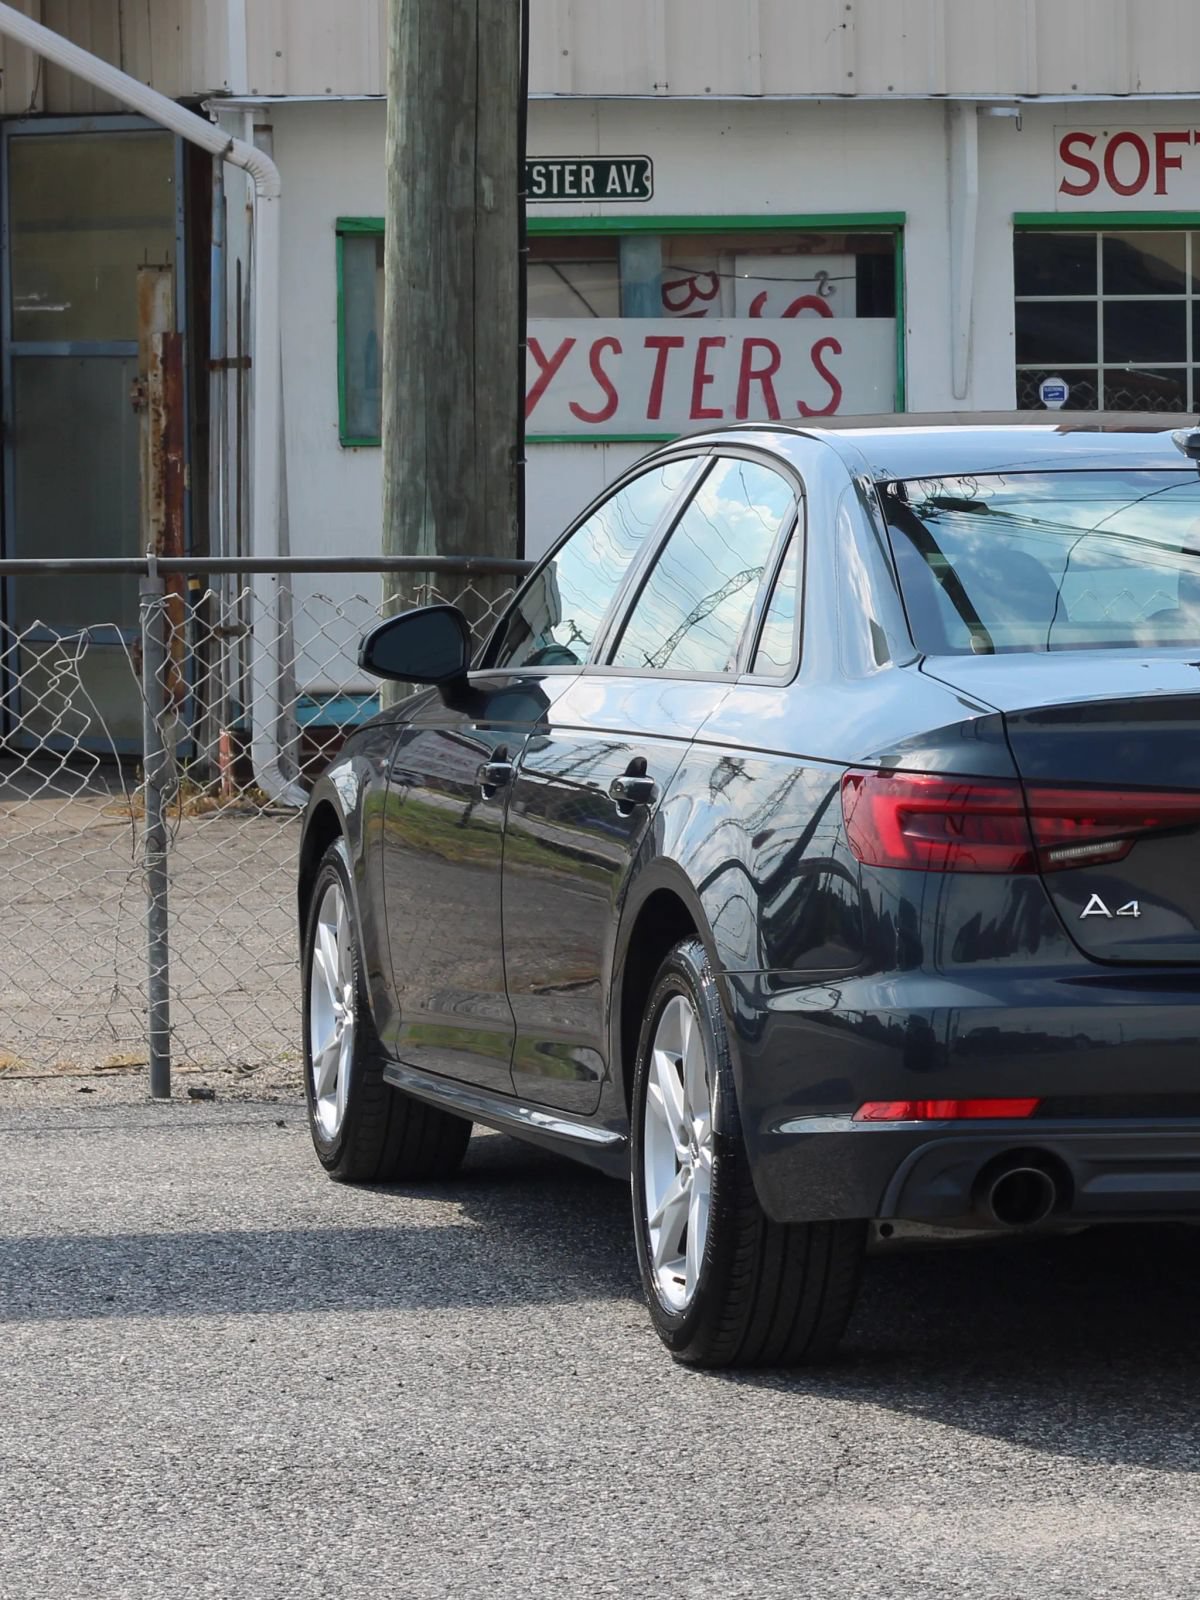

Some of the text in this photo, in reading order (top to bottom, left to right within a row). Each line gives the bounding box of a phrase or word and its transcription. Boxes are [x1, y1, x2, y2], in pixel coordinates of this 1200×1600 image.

[525, 165, 640, 194] STER AV.
[1079, 893, 1141, 919] A4
